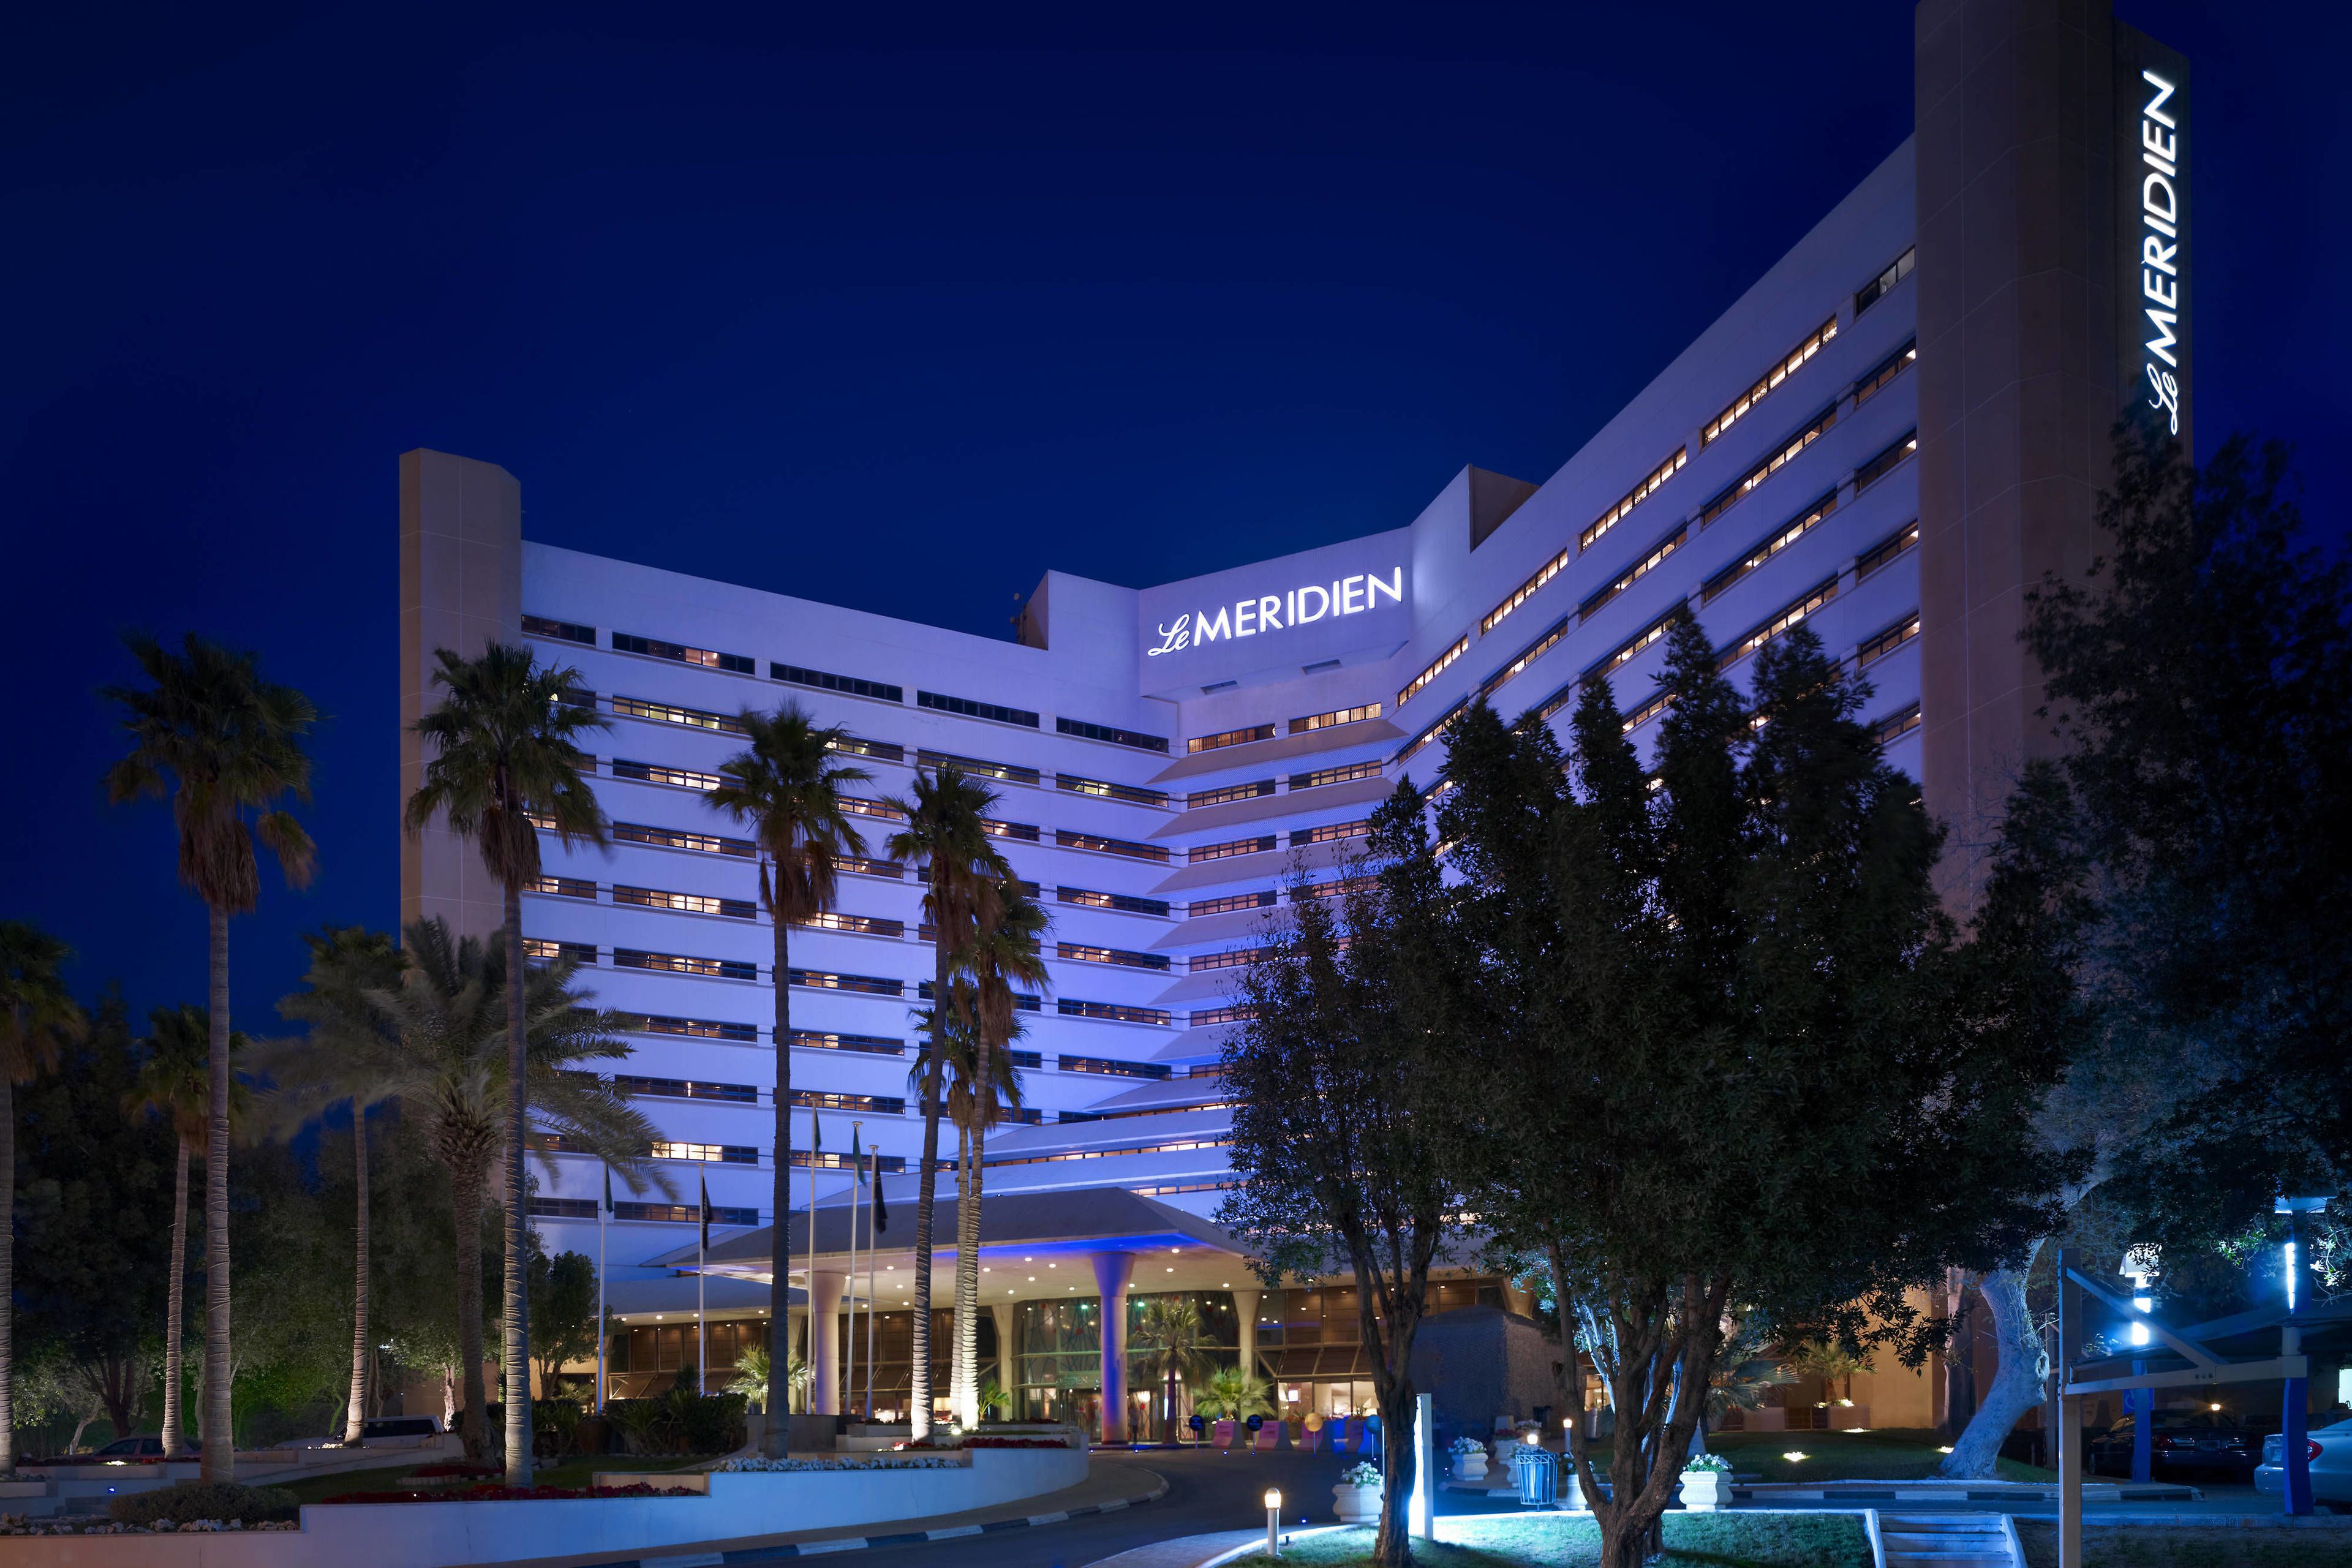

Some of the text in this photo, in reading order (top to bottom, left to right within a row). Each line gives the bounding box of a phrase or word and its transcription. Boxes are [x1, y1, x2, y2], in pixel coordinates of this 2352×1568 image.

[2143, 70, 2178, 435] Le MERIDIEN
[1147, 566, 1402, 657] Le MERIDIEN
